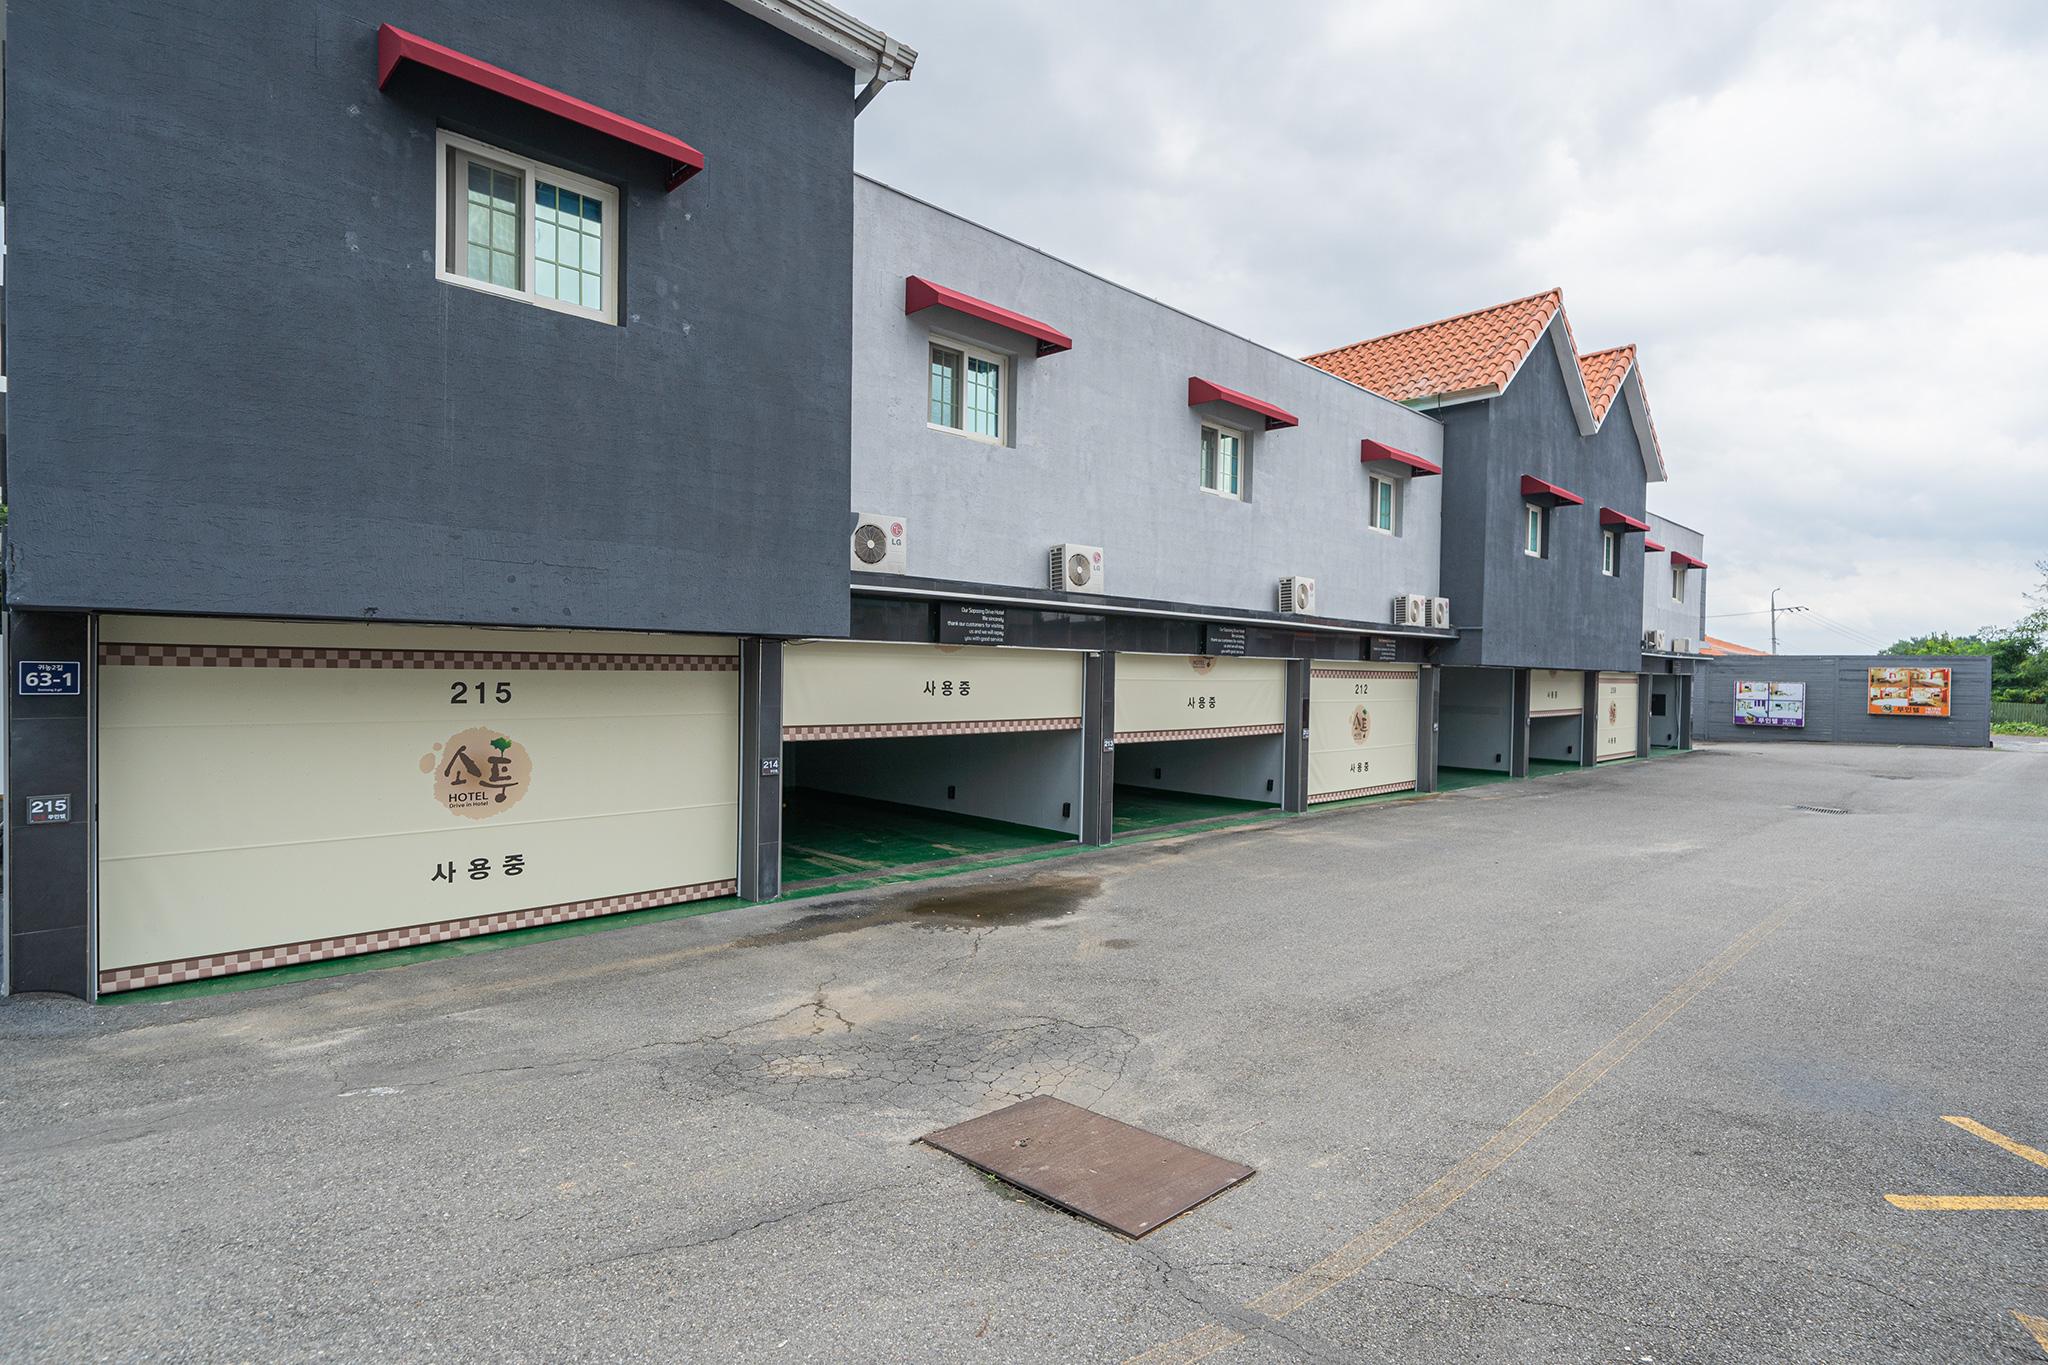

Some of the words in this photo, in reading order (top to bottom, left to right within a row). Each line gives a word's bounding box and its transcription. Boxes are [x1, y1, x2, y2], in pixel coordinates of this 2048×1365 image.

[891, 538, 902, 546] LG
[25, 672, 72, 687] 63-1
[450, 681, 512, 704] 215
[1354, 683, 1368, 695] 212
[763, 760, 778, 769] 214
[448, 791, 489, 803] HOTEL
[31, 799, 67, 813] 215
